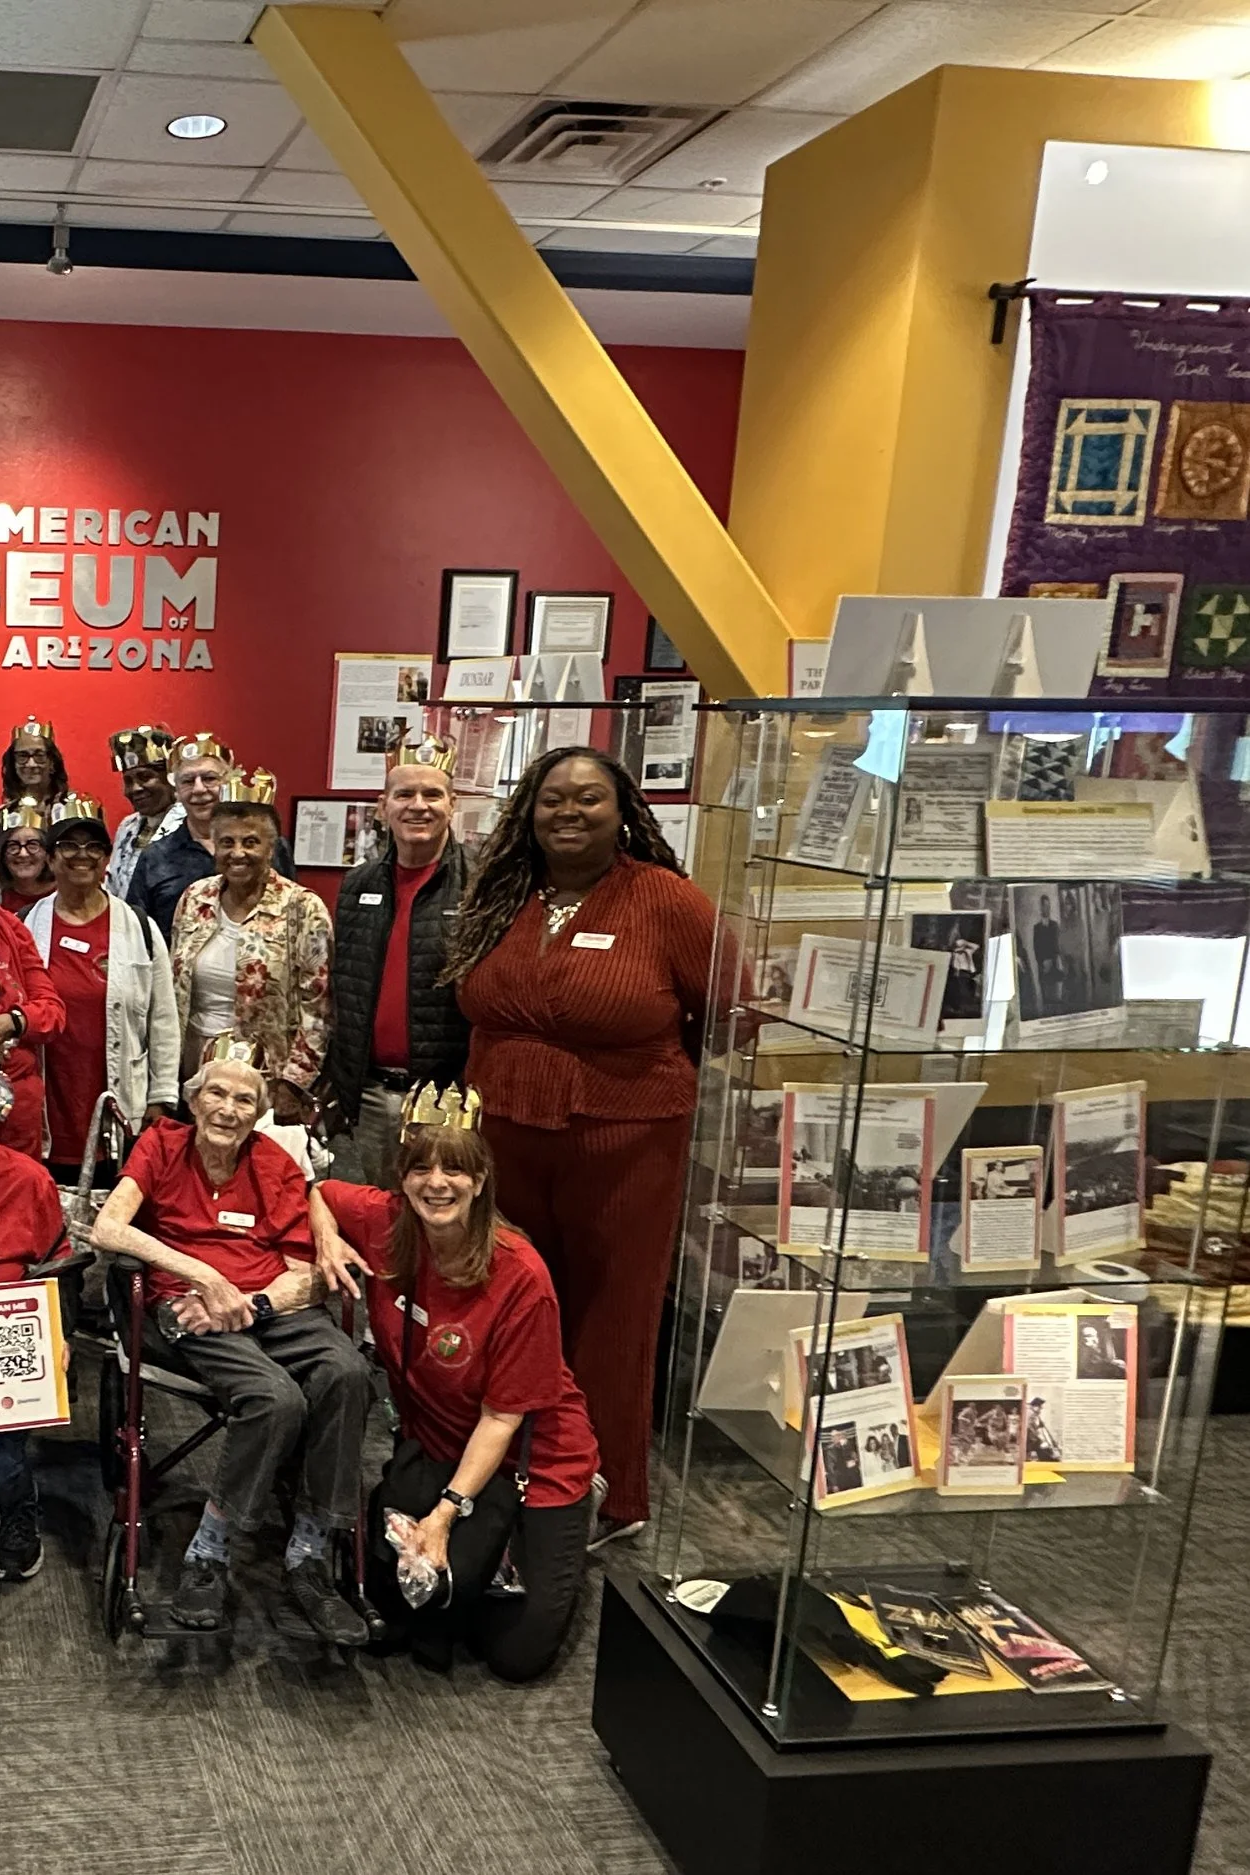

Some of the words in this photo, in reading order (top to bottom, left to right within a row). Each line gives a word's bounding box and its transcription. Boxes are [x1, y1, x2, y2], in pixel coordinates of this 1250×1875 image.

[168, 616, 189, 629] OF
[2, 635, 214, 671] ARIZONA
[805, 667, 825, 678] TH
[799, 680, 822, 690] PAR
[12, 1301, 27, 1311] ME
